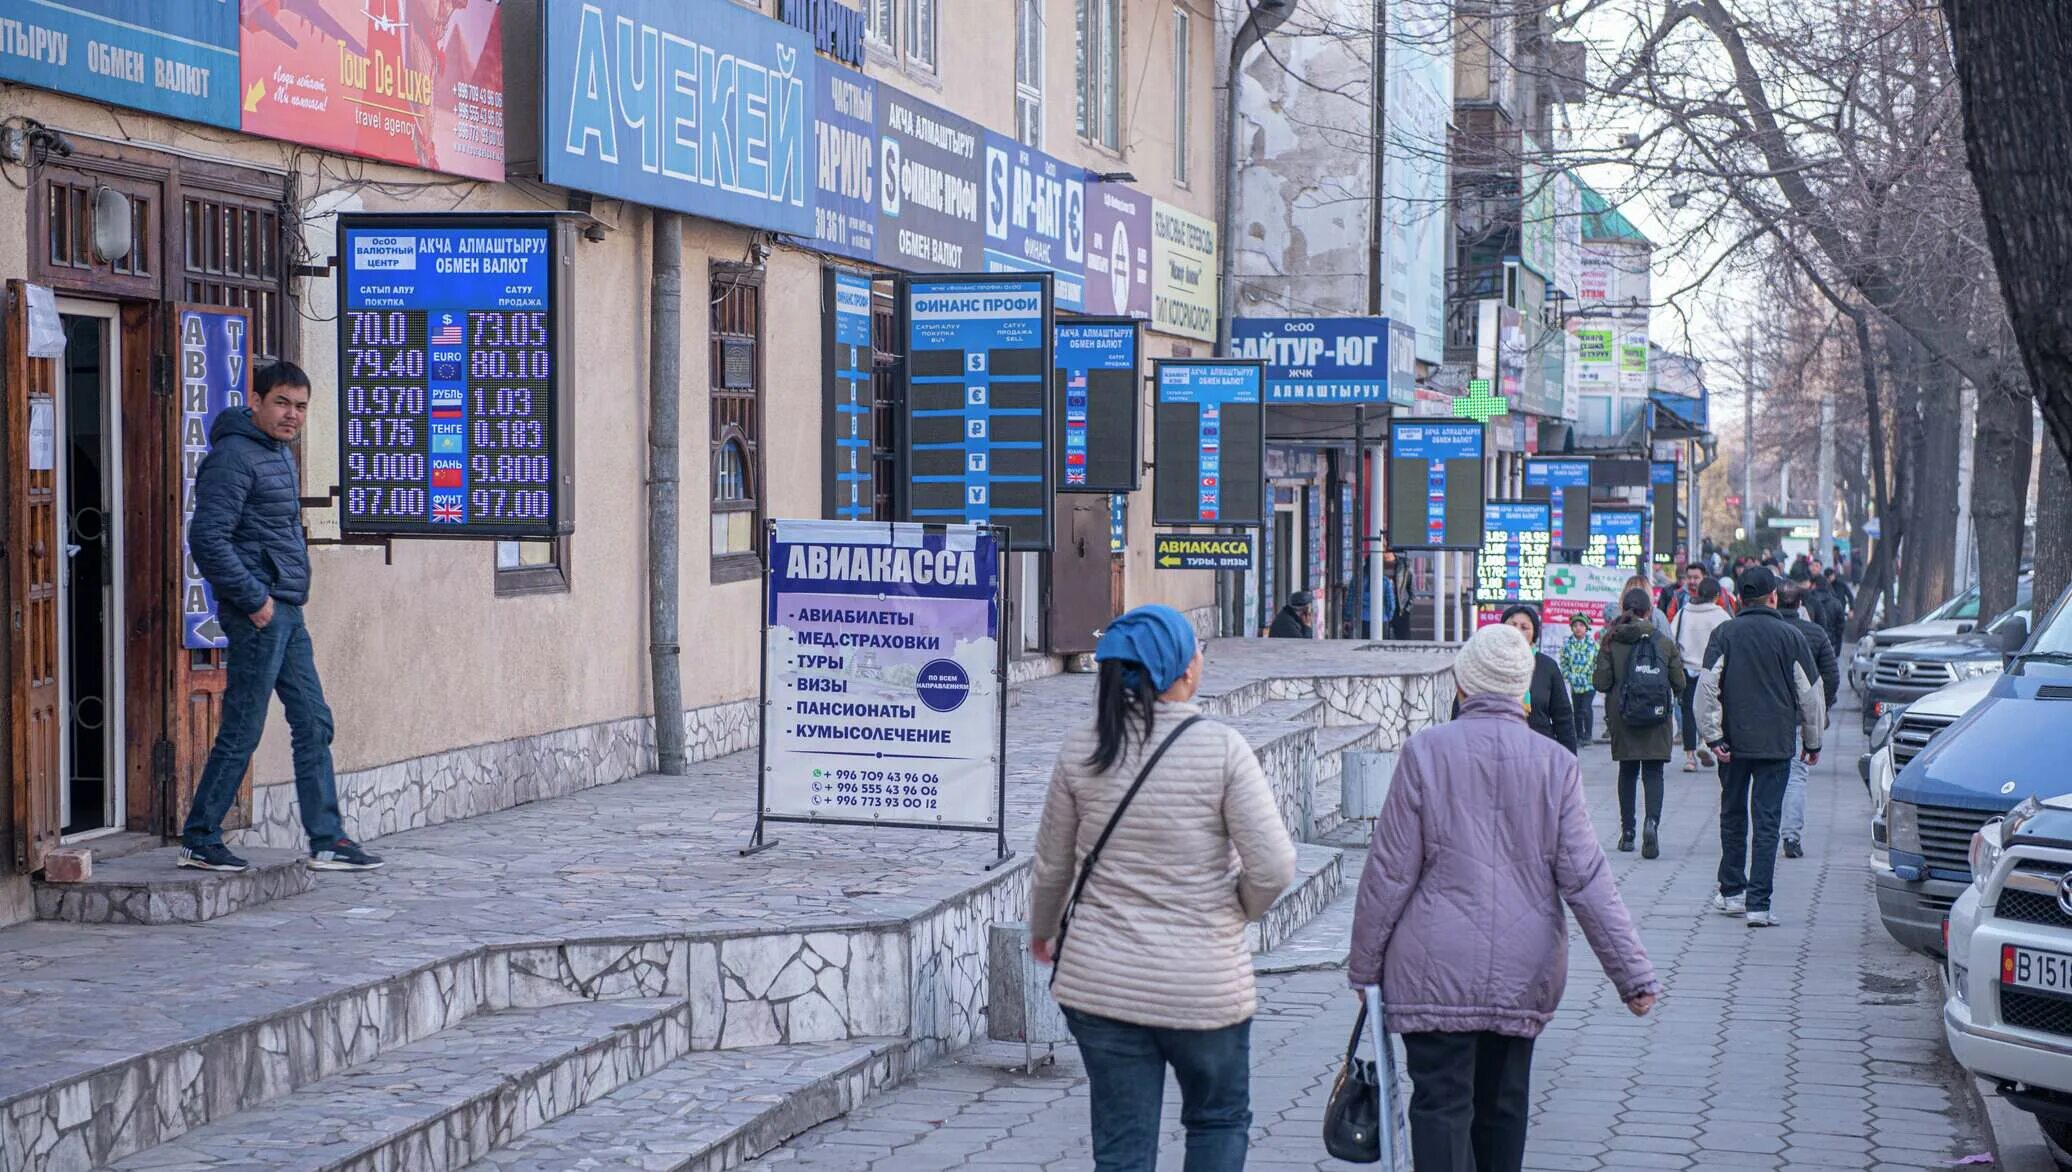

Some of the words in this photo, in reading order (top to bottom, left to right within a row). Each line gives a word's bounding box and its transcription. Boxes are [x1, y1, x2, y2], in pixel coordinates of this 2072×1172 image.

[0, 17, 67, 66] ТЫРУУ
[88, 40, 144, 84] ОБМЕН
[155, 57, 210, 98] ВАЛЮТ
[337, 39, 370, 91] Tour
[374, 49, 393, 96] De
[397, 56, 433, 106] Luxe
[566, 3, 804, 207] АЧЕКЕЙ
[831, 76, 873, 124] ЧАСТНЫЙ
[355, 108, 382, 129] travel
[384, 117, 416, 141] agency
[889, 102, 914, 137] АКЧА
[915, 116, 975, 159] АЛМАШТЫРУУ
[901, 158, 944, 213] ФИНАНС
[945, 174, 977, 223] ПРОФИ
[1012, 166, 1062, 240] АР-БАТ
[357, 246, 414, 255] ВАЛЮТНЫЙ
[419, 238, 451, 254] АКЧА
[458, 238, 548, 254] АЛМАШТЫРУУ
[899, 229, 931, 260] ОБМЕН
[932, 239, 963, 269] ВАЛЮТ
[1024, 236, 1051, 264] ФИНАНС
[368, 260, 400, 268] ЦЕНТР
[436, 258, 480, 273] ОБМЕН
[484, 258, 528, 274] ВАЛЮТ
[360, 286, 391, 294] САТЫП
[392, 286, 415, 294] АЛУУ
[505, 286, 533, 294] САТУУ
[499, 299, 542, 307] ПРОДАЖА
[915, 299, 980, 313] ФИНАНС
[983, 298, 1038, 312] ПРОФИ
[347, 312, 407, 345] 70.0
[469, 312, 548, 347] 73.05
[1060, 330, 1080, 338] АКЧА
[1083, 329, 1133, 338] АЛМАШТЫРУУ
[1284, 322, 1315, 332] ОсОО
[1069, 340, 1095, 348] ОБМЕН
[1096, 340, 1122, 349] ВАЛЮТ
[1231, 331, 1379, 367] БАЙТУР-ЮГ
[347, 349, 424, 377] 79.40
[433, 352, 462, 362] EURO
[472, 350, 549, 379] 80.10
[1288, 369, 1313, 378] ЖЧК
[348, 386, 424, 414] 0.970
[432, 390, 463, 399] РУБЛЬ
[1273, 384, 1380, 398] АЛМАШТЫРУУ
[473, 388, 532, 416] 1.03
[432, 424, 463, 433] ТЕНГЕ
[474, 420, 543, 448] 0.183
[348, 453, 424, 481] 9.000
[433, 460, 463, 469] ЮАНЬ
[472, 455, 549, 483] 9.800
[348, 487, 425, 515] 87.00
[433, 494, 463, 504] ФУНТ
[472, 489, 549, 518] 97.00
[1158, 540, 1249, 554] АВИАКАССА
[786, 545, 977, 586] АВИАКАССА
[798, 608, 914, 626] АВИАБИЛЕТЫ
[798, 631, 940, 650] МЕД.СТРАХОВКИ
[797, 654, 844, 670] ТУРЫ
[797, 677, 847, 693] ВИЗЫ
[917, 682, 969, 690] НАПРАВЛЕНИЯМ
[796, 700, 916, 719] ПАНСИОНАТЫ
[796, 724, 952, 744] КУМЫСОЛЕЧЕНИЕ
[836, 770, 857, 780] 996
[860, 770, 884, 781] 709
[887, 772, 901, 783] 43
[904, 772, 919, 784] 96
[922, 773, 939, 784] 06
[837, 783, 858, 794] 996
[861, 784, 882, 794] 555
[885, 785, 900, 795] 43
[903, 785, 918, 796] 96
[921, 786, 938, 797] 06
[837, 795, 858, 806] 996
[861, 797, 882, 807] 773
[885, 797, 900, 808] 93
[903, 798, 922, 808] 00
[925, 799, 938, 809] 12
[2018, 952, 2031, 981] B
